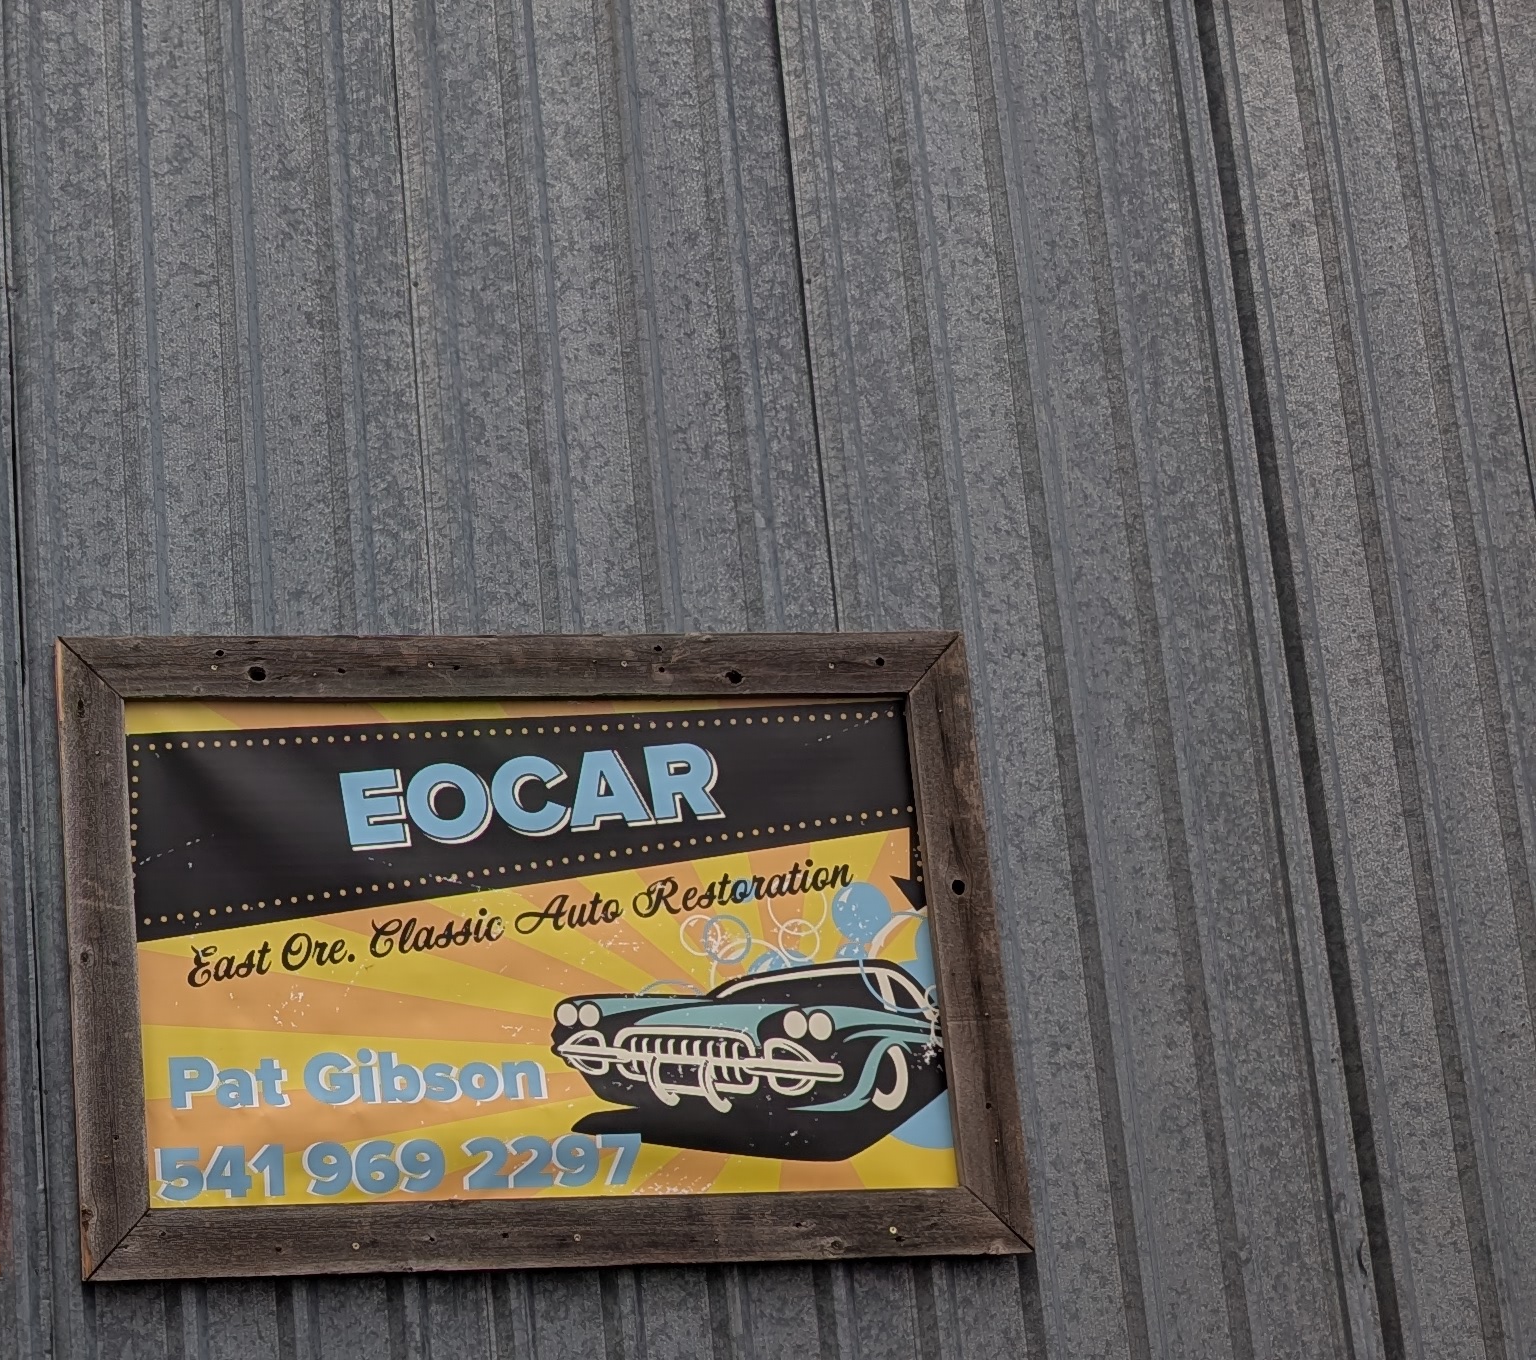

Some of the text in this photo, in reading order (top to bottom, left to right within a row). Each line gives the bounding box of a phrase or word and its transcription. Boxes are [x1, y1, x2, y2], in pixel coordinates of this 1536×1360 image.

[339, 741, 725, 851] EOCAR
[186, 858, 854, 988] East Ore. Classic Auto Restoration
[167, 1048, 548, 1111] Pat Gibson
[155, 1131, 643, 1202] 541 969 2297
